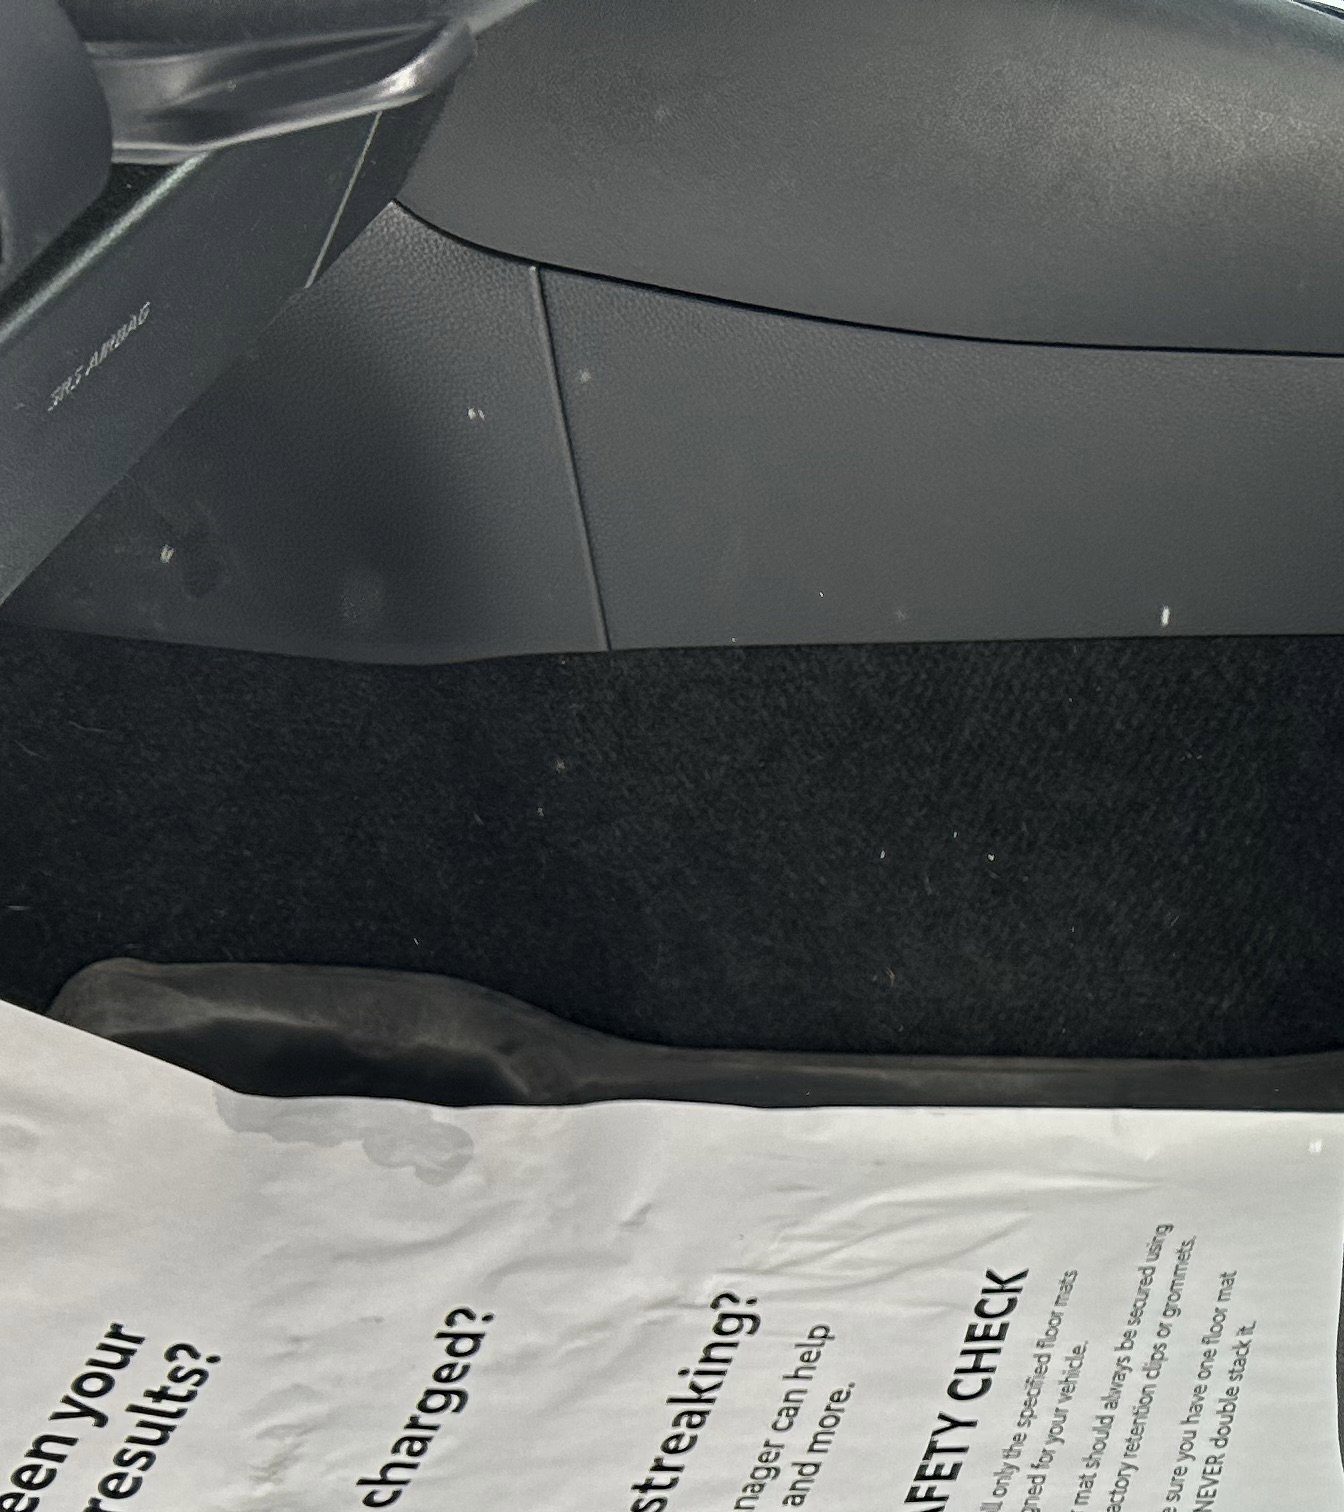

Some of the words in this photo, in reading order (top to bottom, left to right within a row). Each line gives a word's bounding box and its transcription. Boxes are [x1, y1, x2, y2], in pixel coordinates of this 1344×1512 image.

[1146, 1223, 1174, 1263] using
[1055, 1269, 1078, 1308] mats
[1127, 1264, 1156, 1328] secured
[1162, 1235, 1197, 1320] grommets.
[1217, 1269, 1238, 1303] mat
[946, 1267, 1029, 1400] CHECK
[1036, 1309, 1064, 1351] floor
[1114, 1329, 1135, 1353] be
[1156, 1322, 1172, 1339] or
[1201, 1306, 1229, 1346] floor
[782, 1323, 836, 1381] help
[1142, 1337, 1169, 1381] clips
[1197, 1347, 1217, 1381] one
[1229, 1339, 1253, 1383] stack
[48, 1322, 146, 1428] your
[1016, 1352, 1051, 1428] specified
[1100, 1356, 1133, 1411] always
[356, 1307, 494, 1510] charged?
[771, 1388, 808, 1432] can
[1030, 1447, 1055, 1471] for
[1045, 1406, 1069, 1446] your
[1058, 1340, 1088, 1403] vehicle.
[1124, 1383, 1153, 1458] retention
[1180, 1384, 1208, 1426] have
[1208, 1384, 1240, 1450] double
[782, 1461, 822, 1507] and
[807, 1382, 856, 1453] more.
[1002, 1432, 1026, 1460] the
[1081, 1414, 1114, 1470] should
[1176, 1430, 1197, 1463] you
[992, 1461, 1020, 1499] only
[1074, 1469, 1097, 1507] mat
[1168, 1464, 1188, 1503] sure
[1195, 1453, 1226, 1512] NEVER
